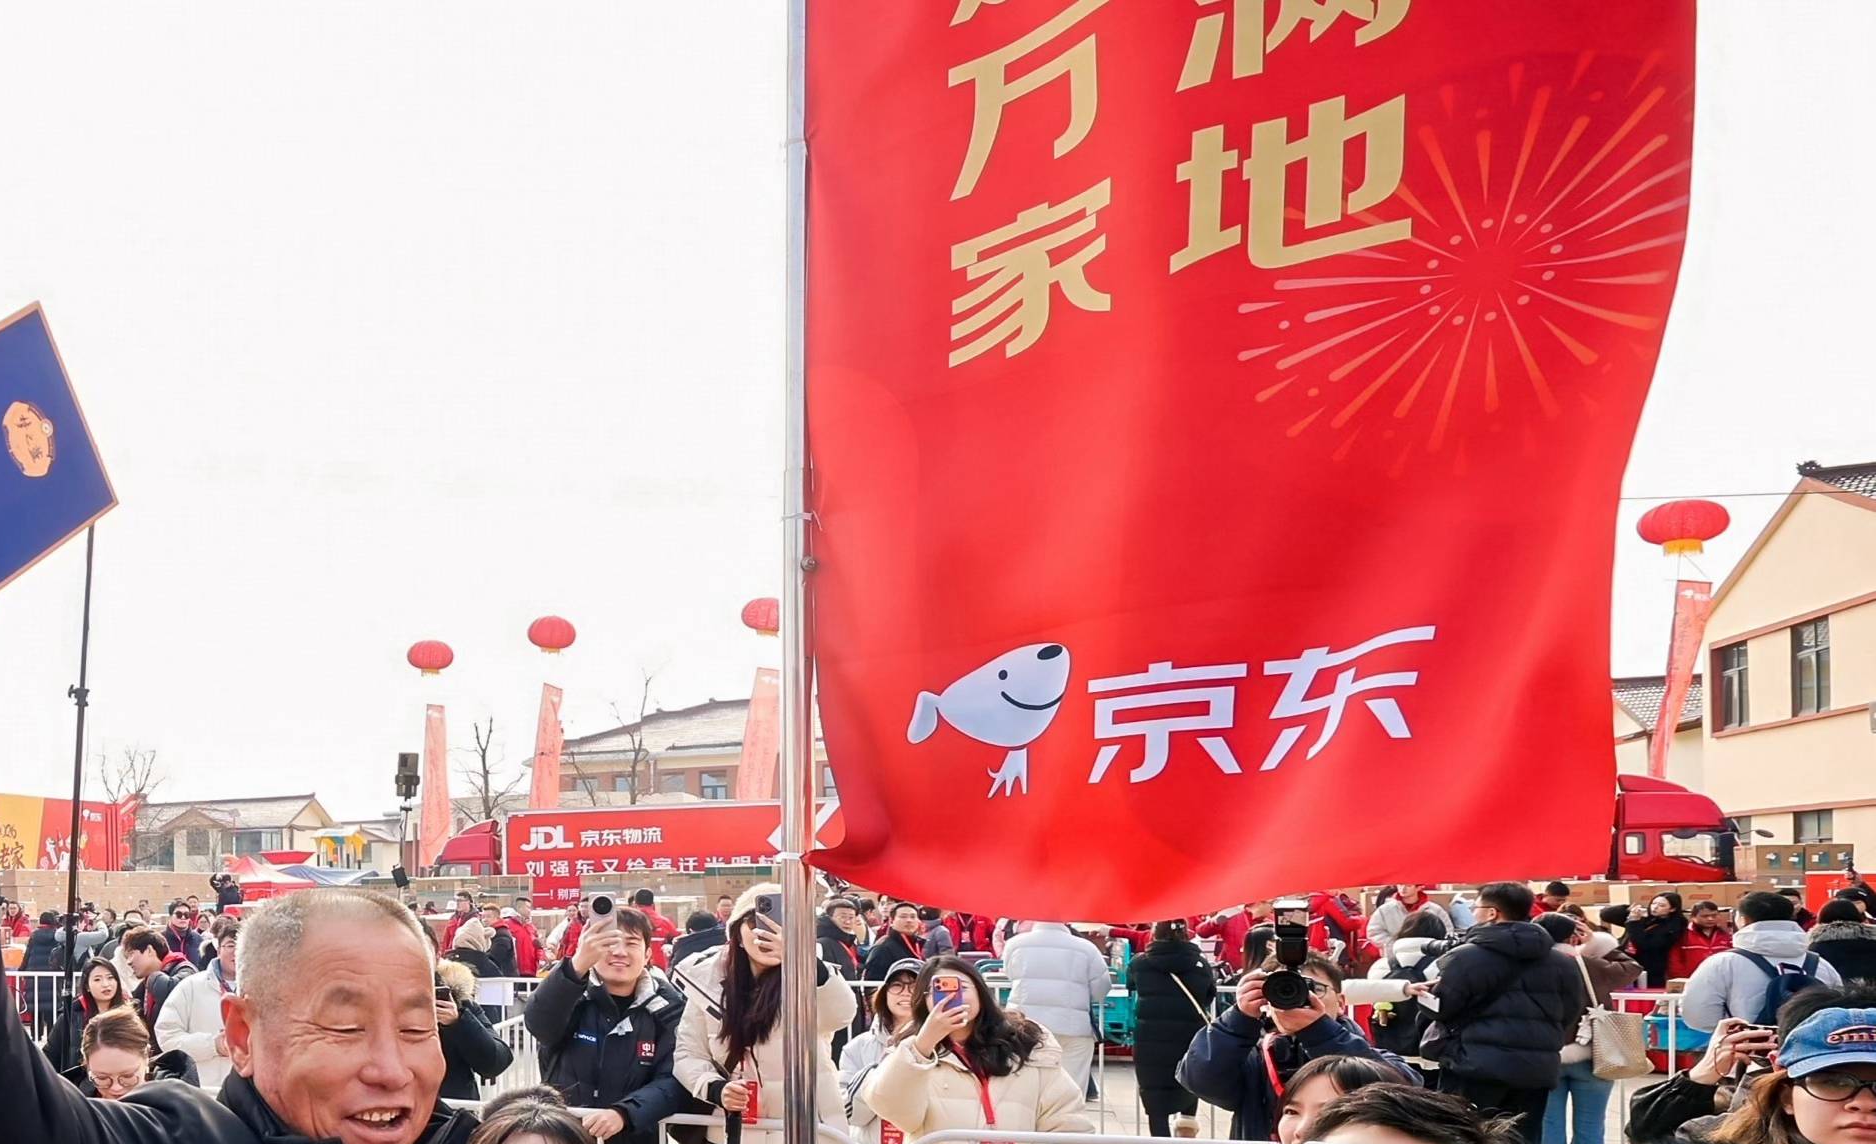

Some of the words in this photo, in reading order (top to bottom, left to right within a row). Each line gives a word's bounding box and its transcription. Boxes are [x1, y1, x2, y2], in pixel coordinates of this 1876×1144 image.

[948, 0, 1112, 368] 万家
[1087, 625, 1436, 784] 京东
[520, 826, 573, 850] JDL
[580, 827, 662, 847] 京东物流
